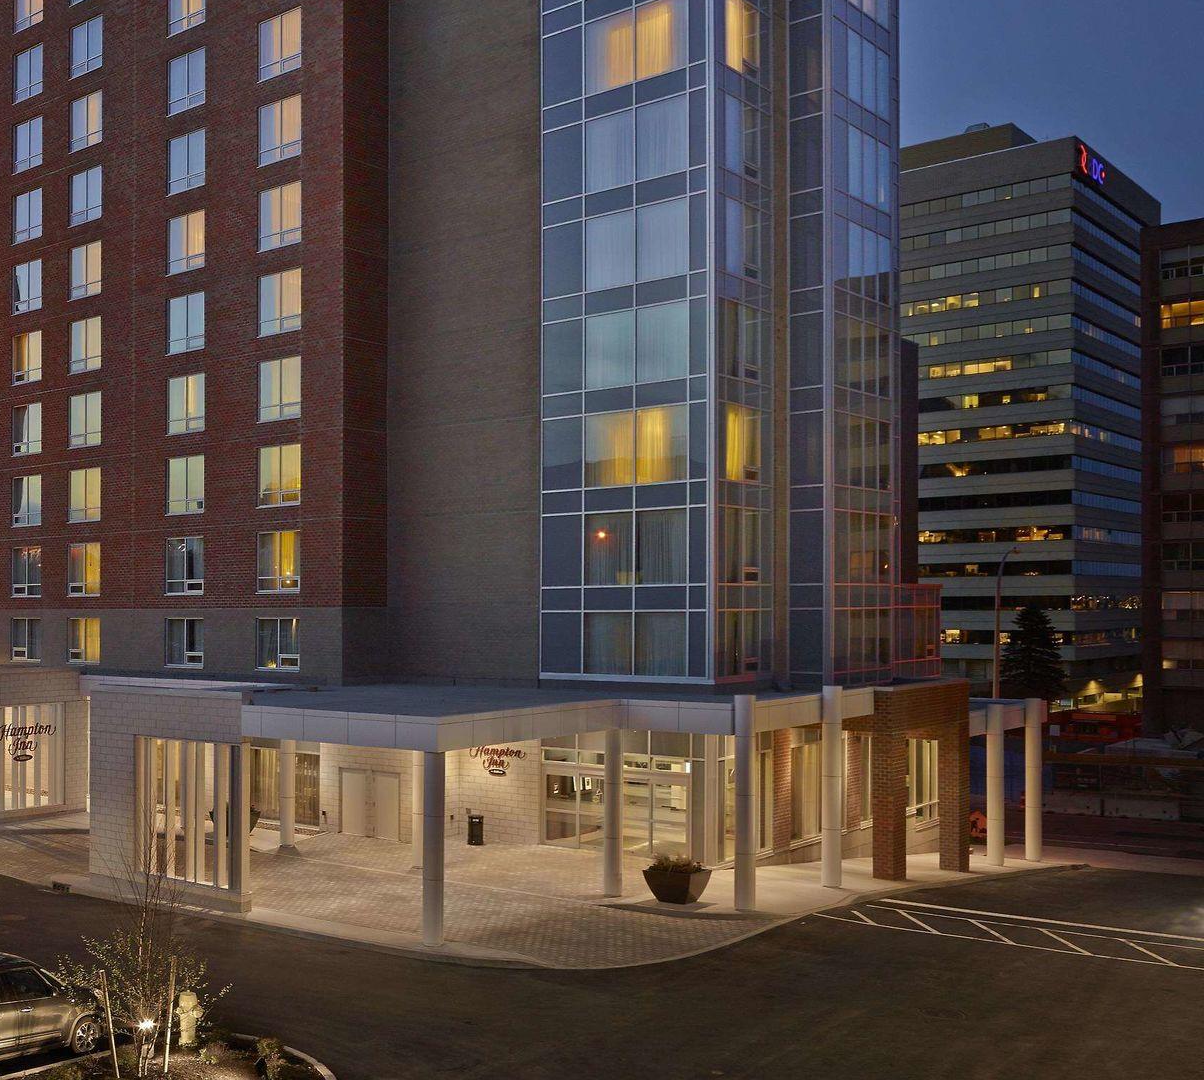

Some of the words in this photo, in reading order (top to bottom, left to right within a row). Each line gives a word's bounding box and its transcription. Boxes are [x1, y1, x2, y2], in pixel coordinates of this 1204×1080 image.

[8, 738, 37, 755] Inn
[469, 745, 527, 760] Hampton
[482, 756, 510, 770] Inn
